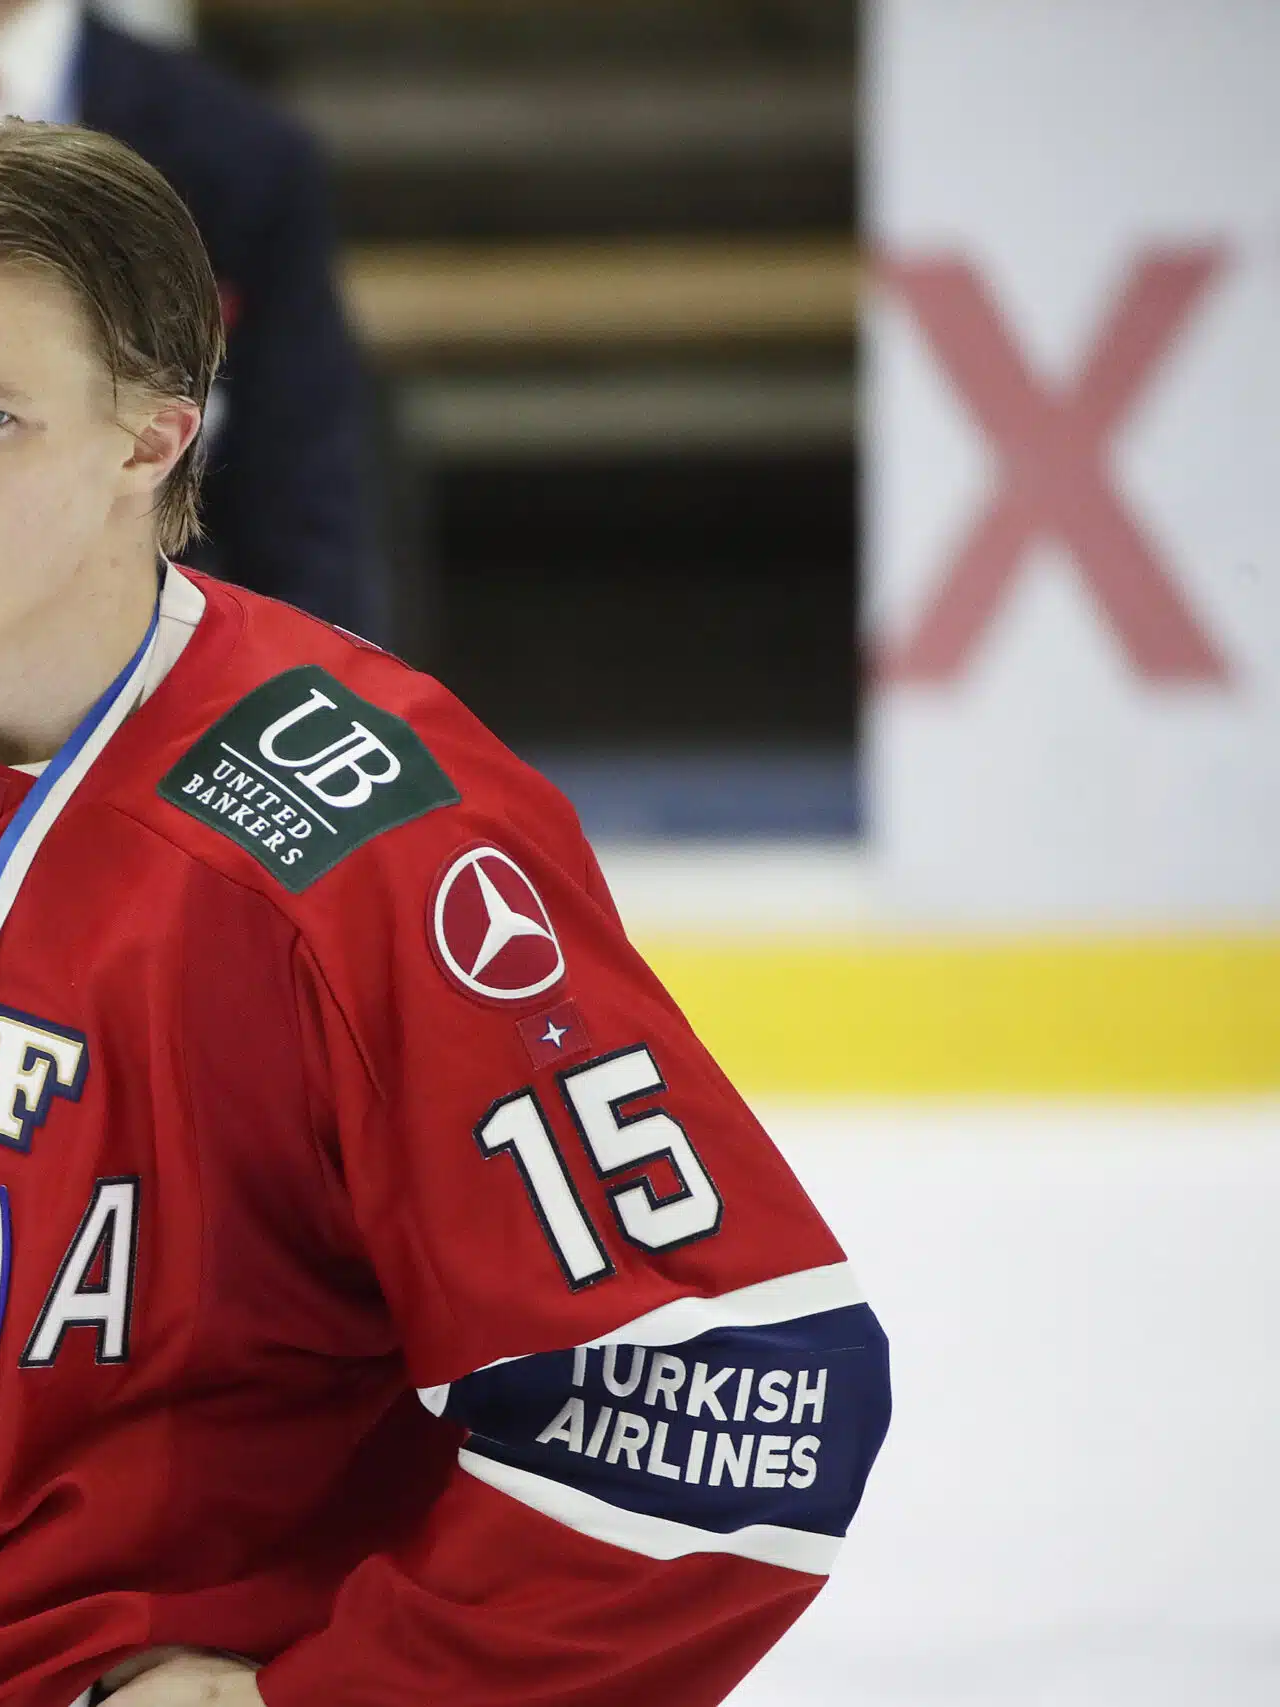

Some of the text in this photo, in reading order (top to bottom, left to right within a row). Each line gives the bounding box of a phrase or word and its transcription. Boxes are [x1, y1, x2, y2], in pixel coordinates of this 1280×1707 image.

[258, 687, 402, 808] UB
[181, 773, 304, 866] BANKERS
[211, 759, 313, 840] UNITED
[472, 1043, 725, 1293] 15
[18, 1175, 140, 1369] A
[571, 1343, 828, 1425] TURKISH
[535, 1396, 822, 1490] AIRLINES
